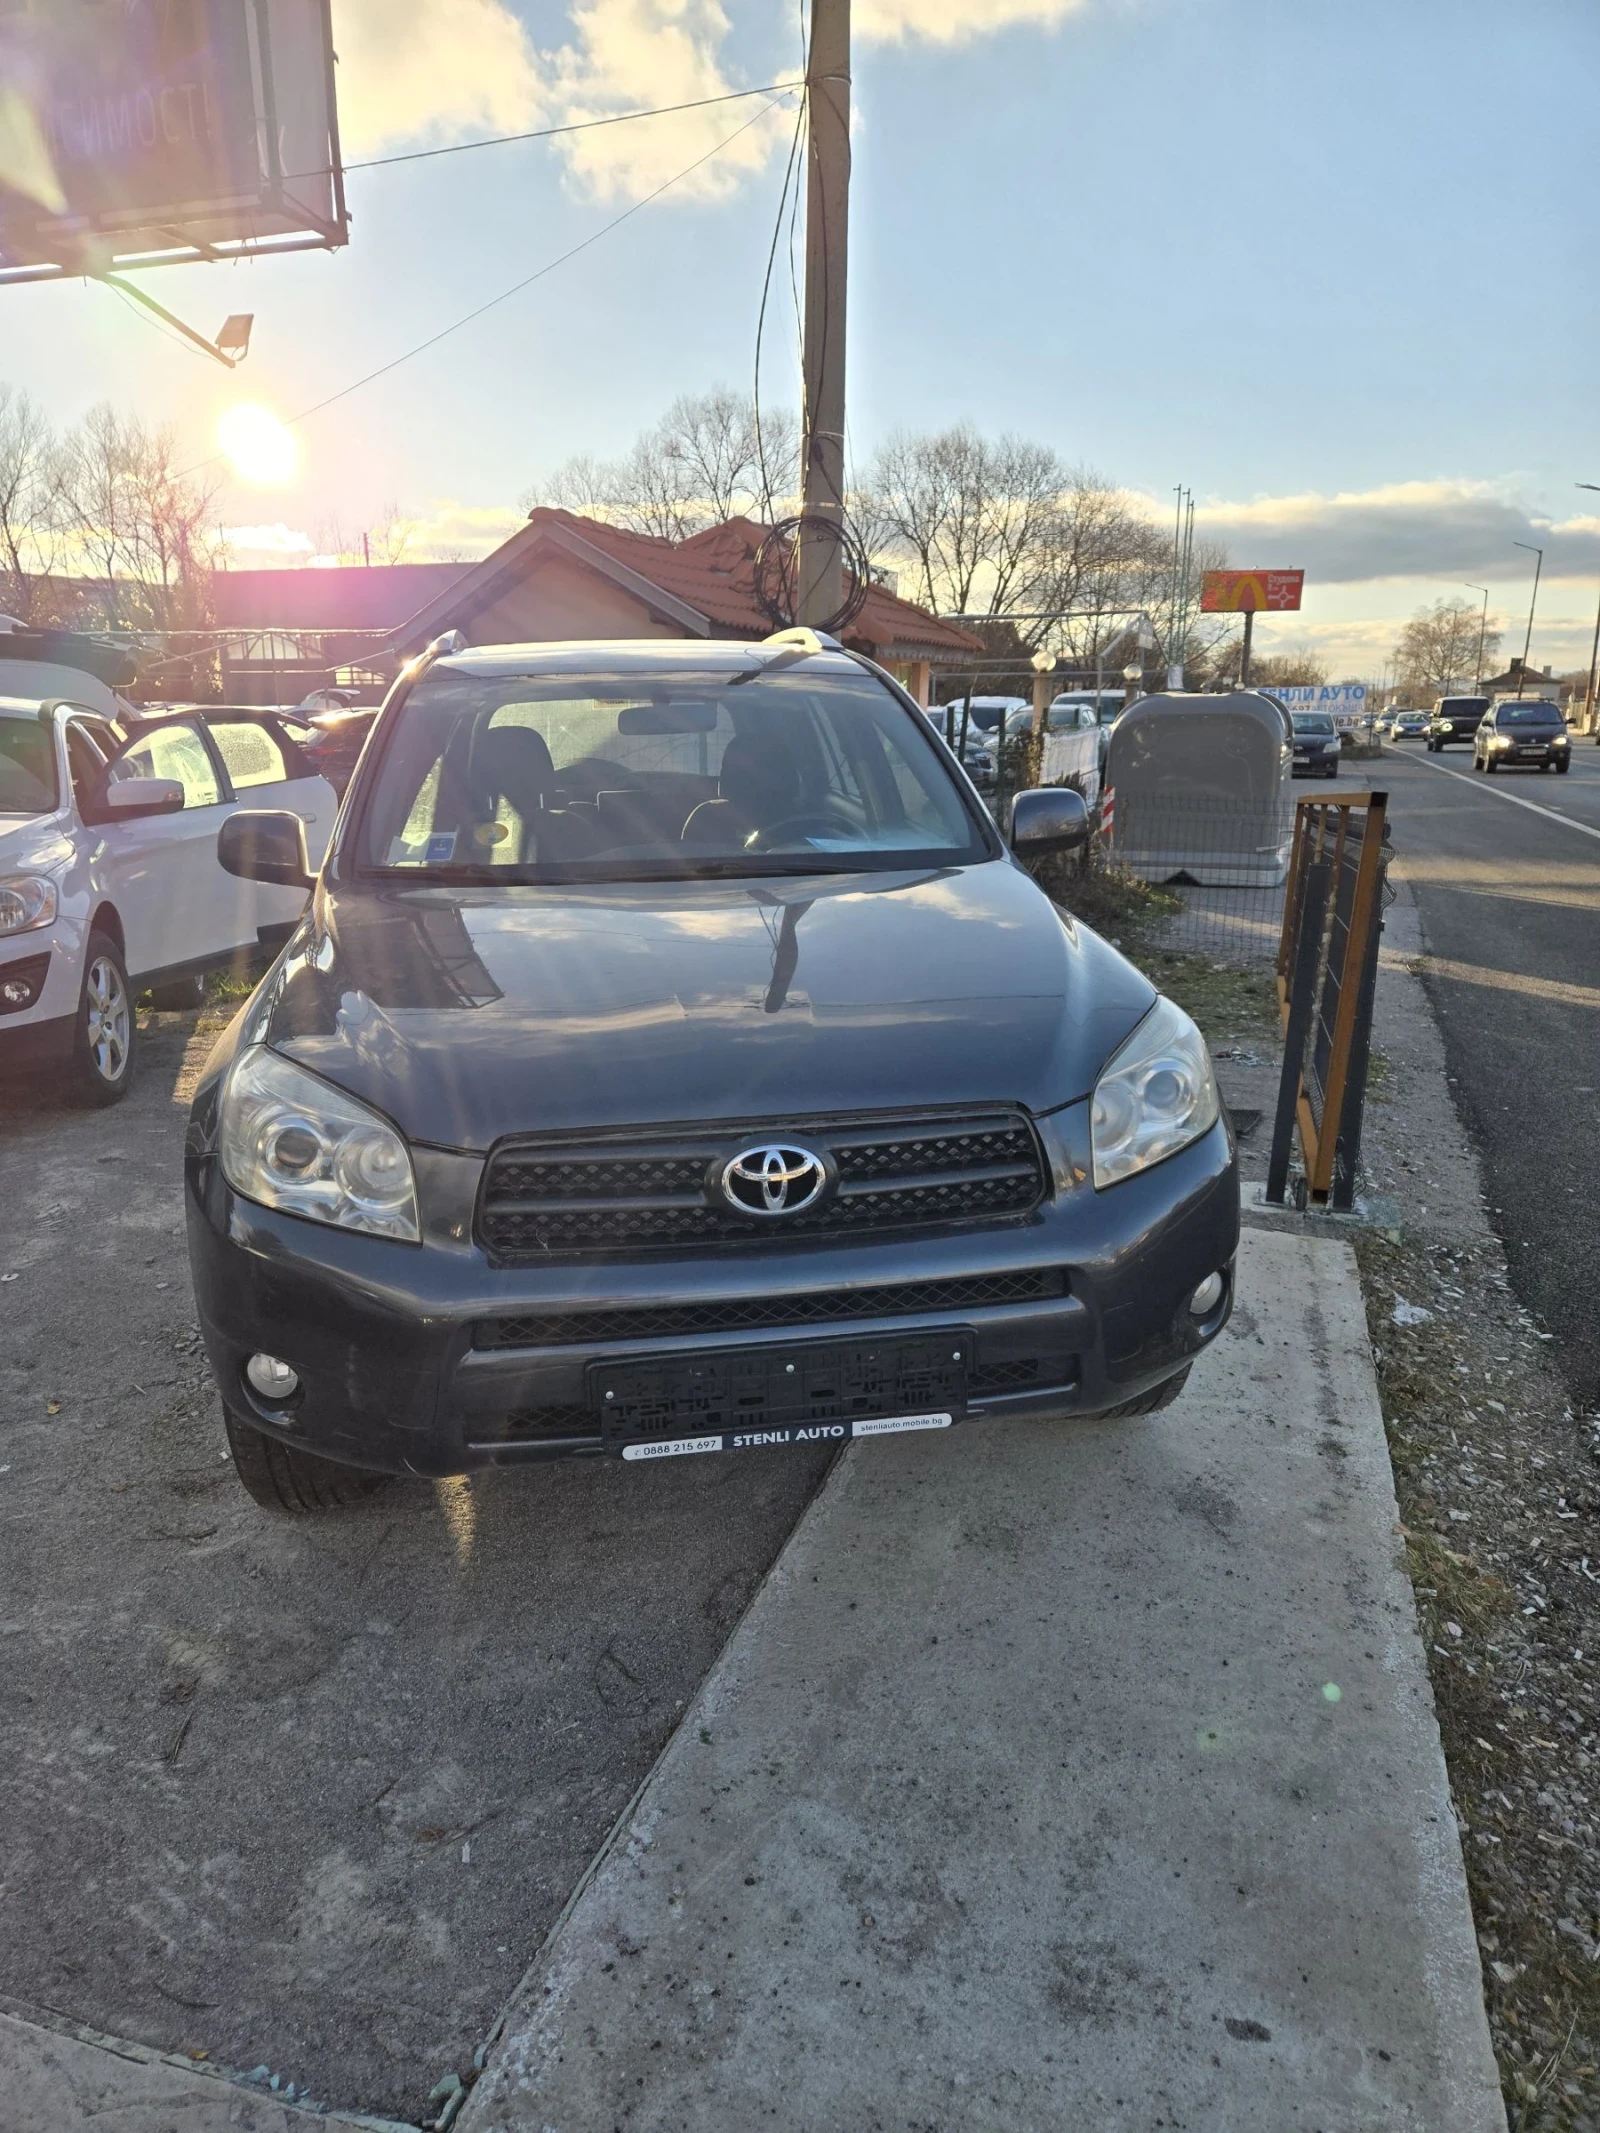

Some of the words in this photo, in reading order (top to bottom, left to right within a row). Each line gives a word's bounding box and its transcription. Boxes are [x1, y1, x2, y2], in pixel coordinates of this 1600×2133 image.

[1320, 686, 1365, 700] АУТО
[860, 1417, 943, 1432] stenliauto.mobile.bg
[733, 1430, 790, 1447] STENLI
[795, 1425, 845, 1441] AUTO
[644, 1445, 670, 1456] 0888
[673, 1442, 694, 1452] 215
[696, 1440, 716, 1450] 697
